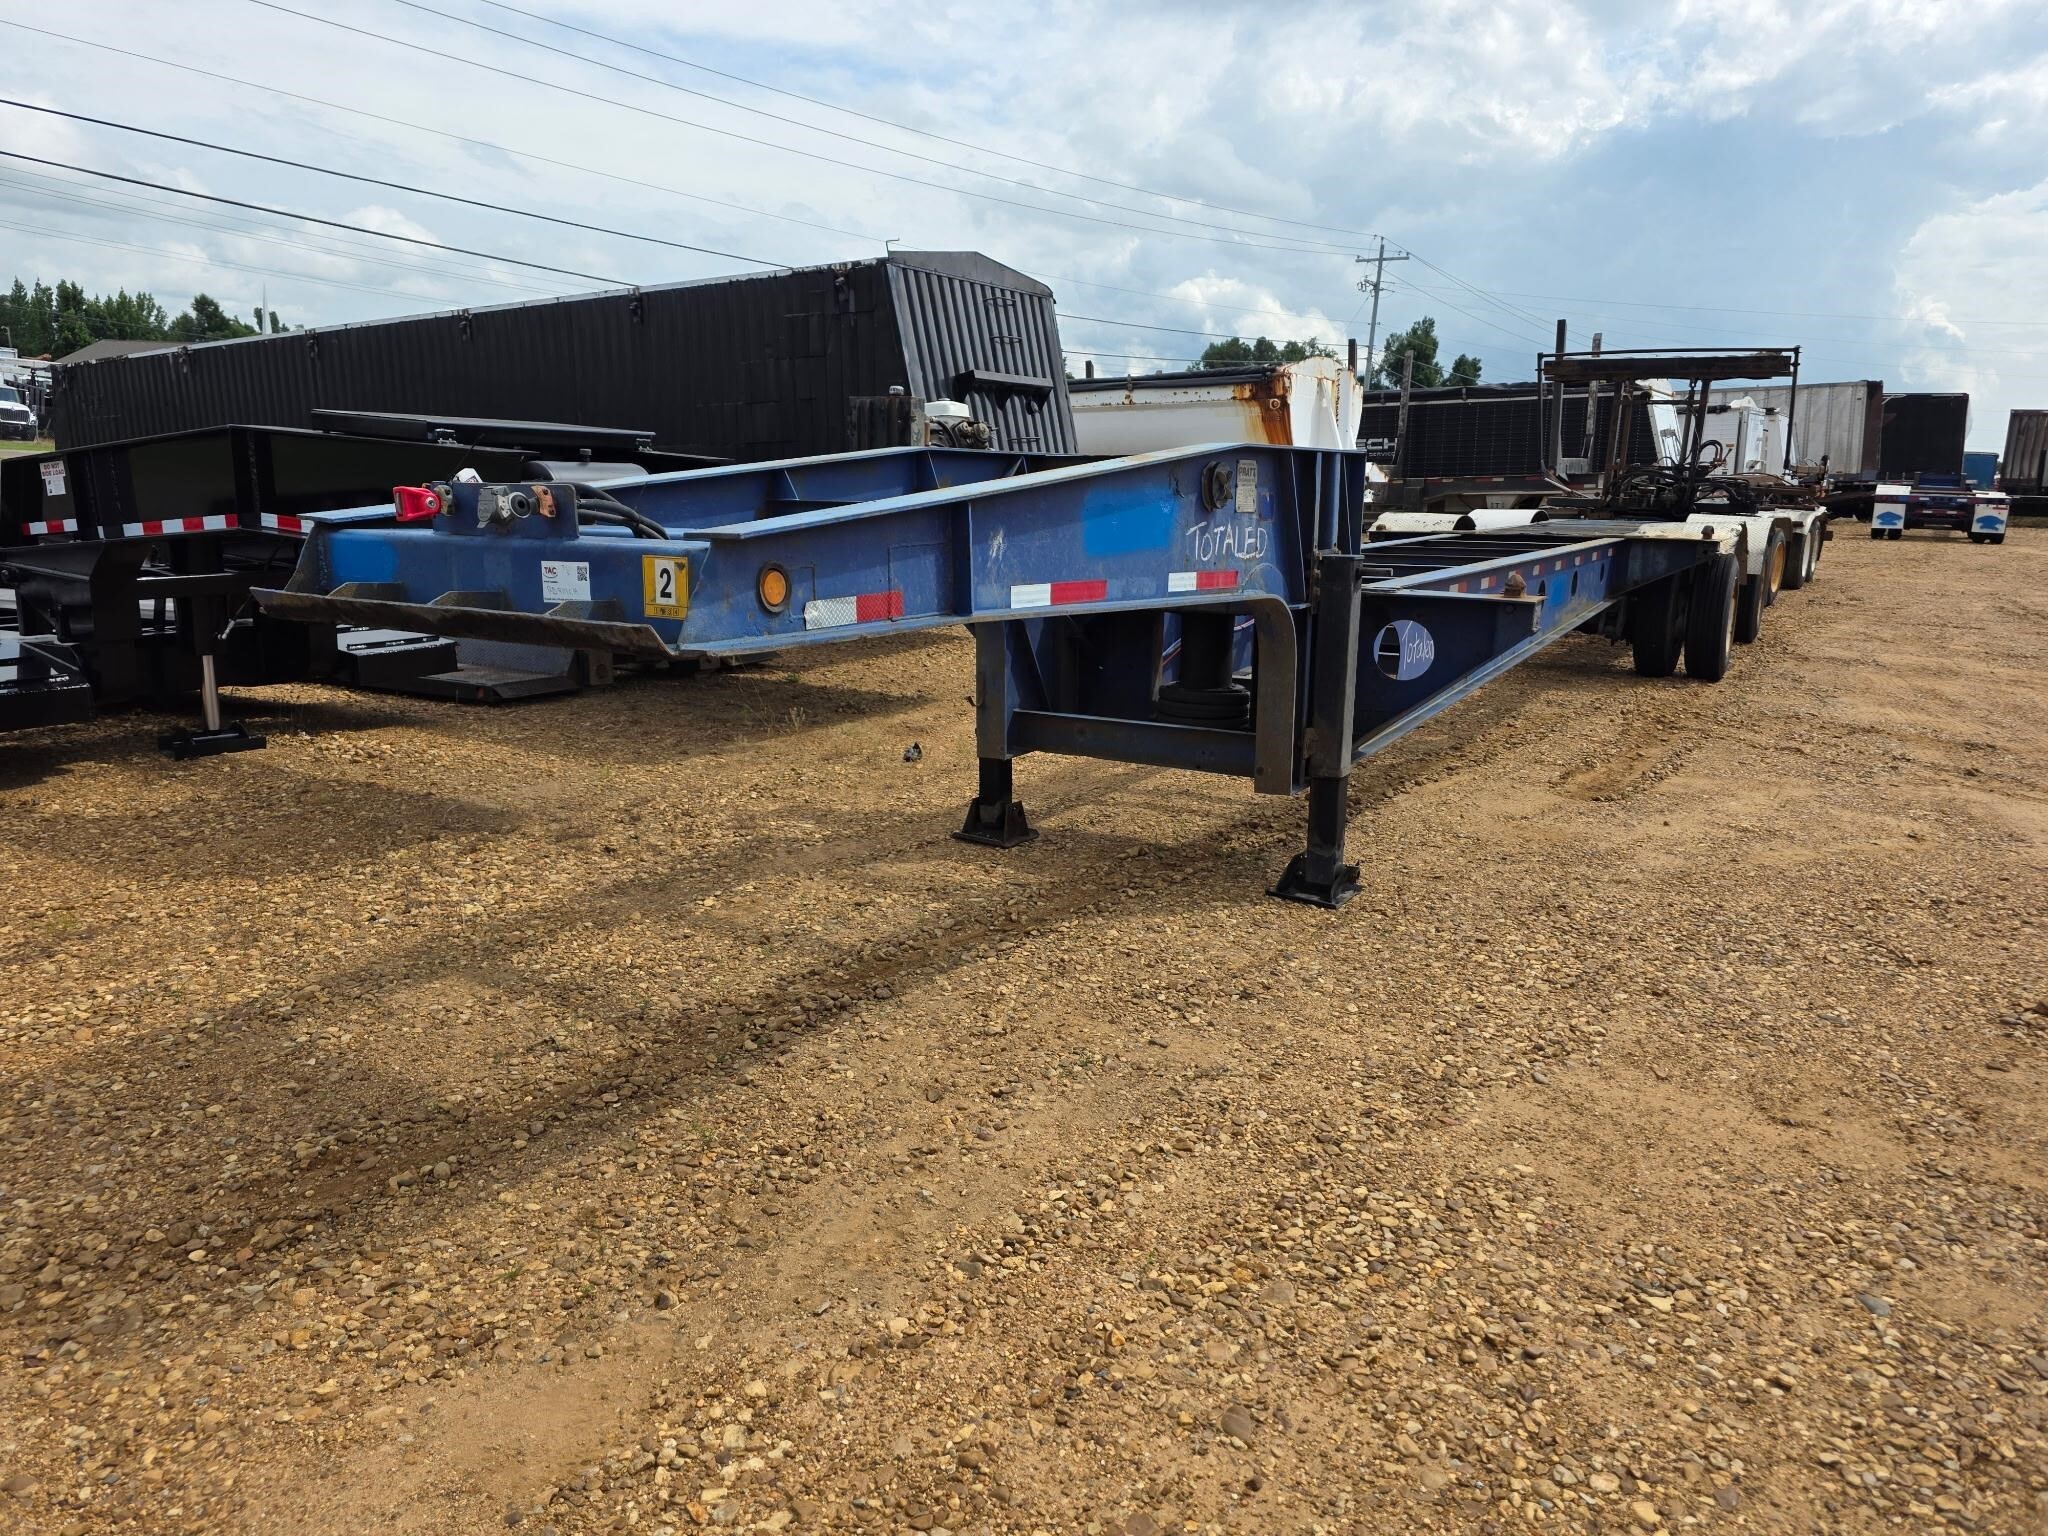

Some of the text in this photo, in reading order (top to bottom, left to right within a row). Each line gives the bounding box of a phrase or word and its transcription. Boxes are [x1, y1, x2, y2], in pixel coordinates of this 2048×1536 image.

[1186, 521, 1268, 561] TOTALED
[543, 566, 557, 575] TAC
[659, 567, 672, 599] 2
